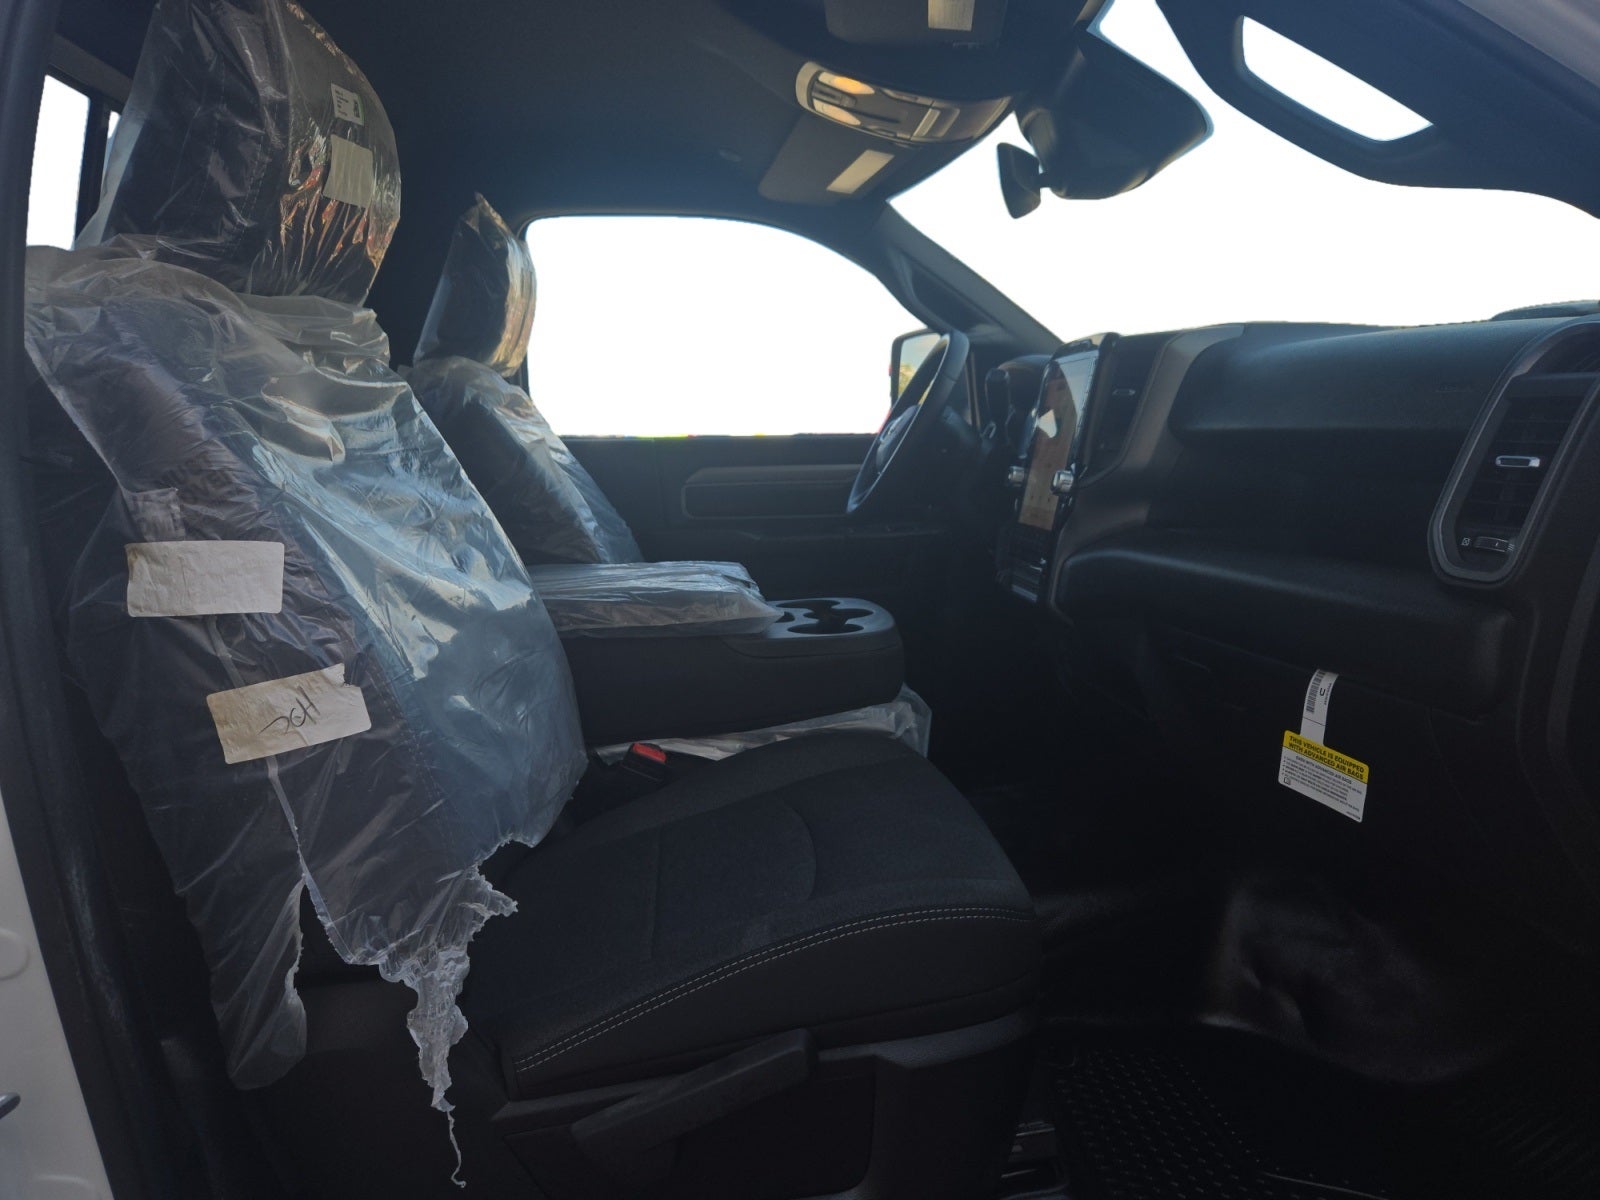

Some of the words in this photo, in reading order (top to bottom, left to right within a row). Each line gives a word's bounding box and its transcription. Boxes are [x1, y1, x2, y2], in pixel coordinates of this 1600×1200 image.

[1288, 742, 1304, 753] WITH
[1303, 749, 1335, 767] ADVANCED
[1336, 762, 1347, 772] AIR
[1347, 767, 1364, 780] BAGS
[1289, 735, 1302, 746] THIS
[1303, 741, 1327, 757] VEHICLE
[1335, 755, 1365, 774] EQUIPPED
